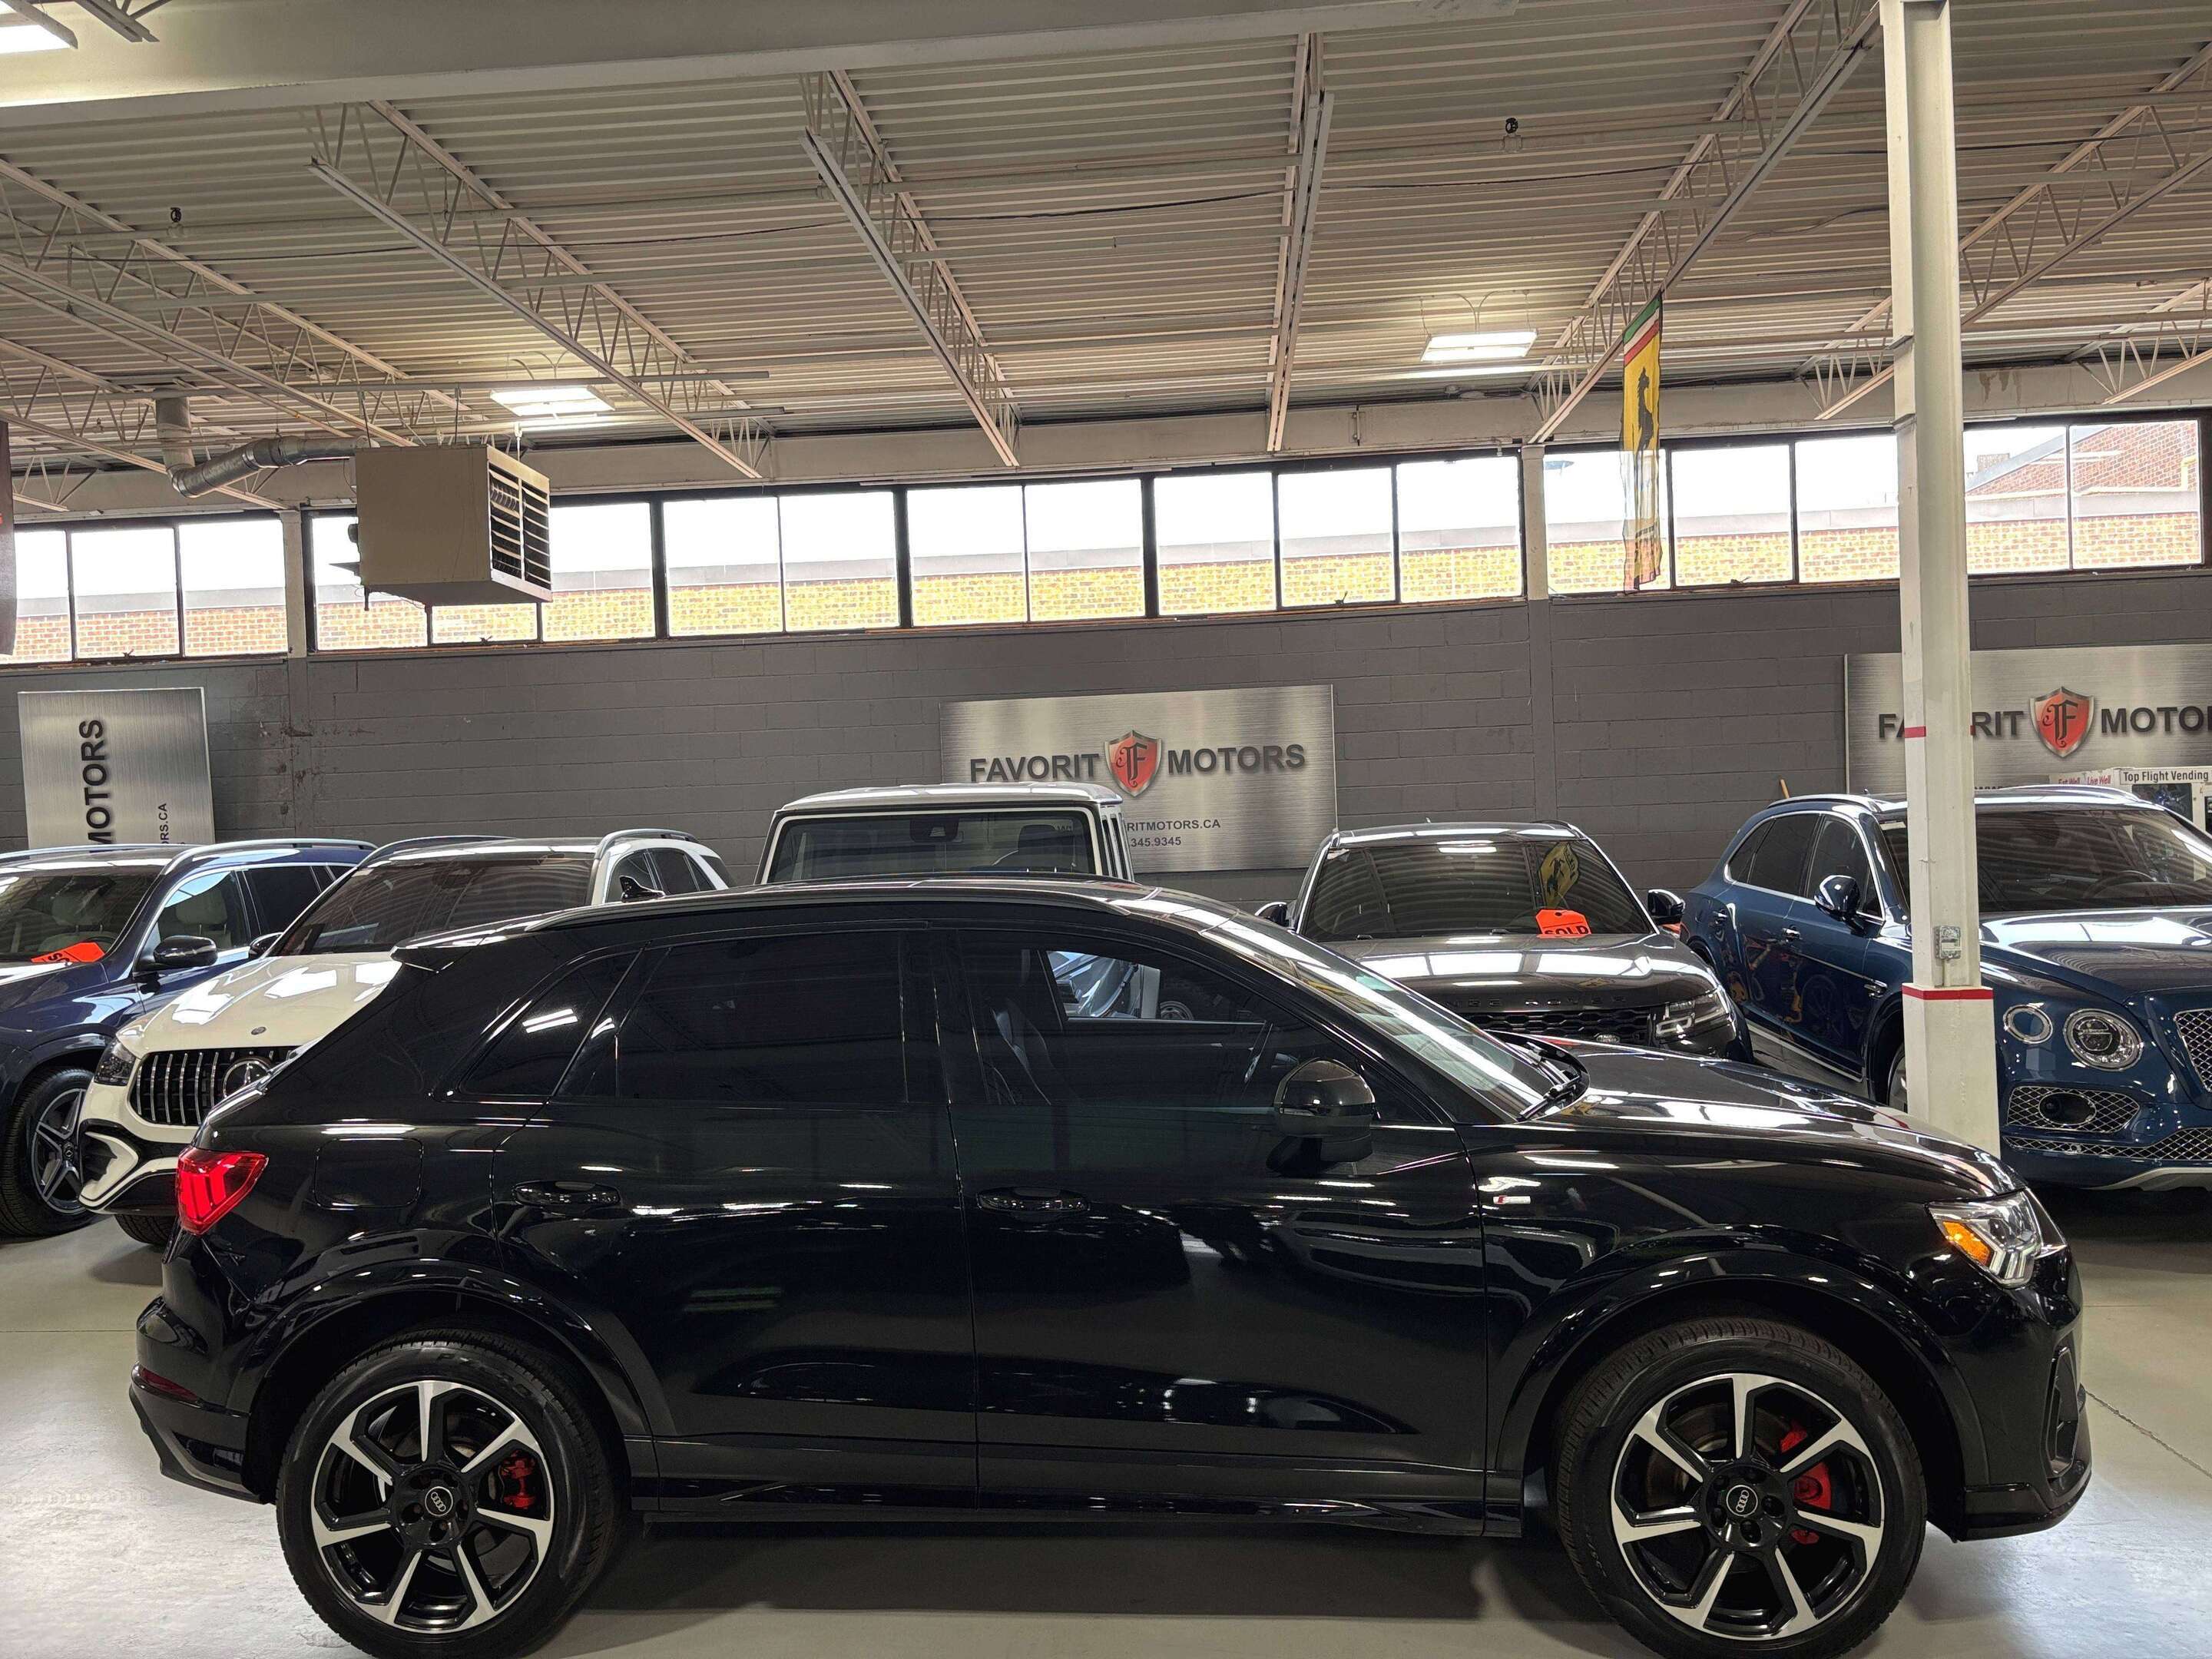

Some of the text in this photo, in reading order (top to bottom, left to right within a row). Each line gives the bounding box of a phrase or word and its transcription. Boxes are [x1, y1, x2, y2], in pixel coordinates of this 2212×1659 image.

[1879, 706, 2212, 738] FRIT MOTO
[970, 743, 1305, 782] FAVORIT MOTORS
[2123, 770, 2209, 783] Top Flight Vending
[1126, 819, 1220, 832] RITMOTORS.CA
[1129, 836, 1181, 847] 345.9345
